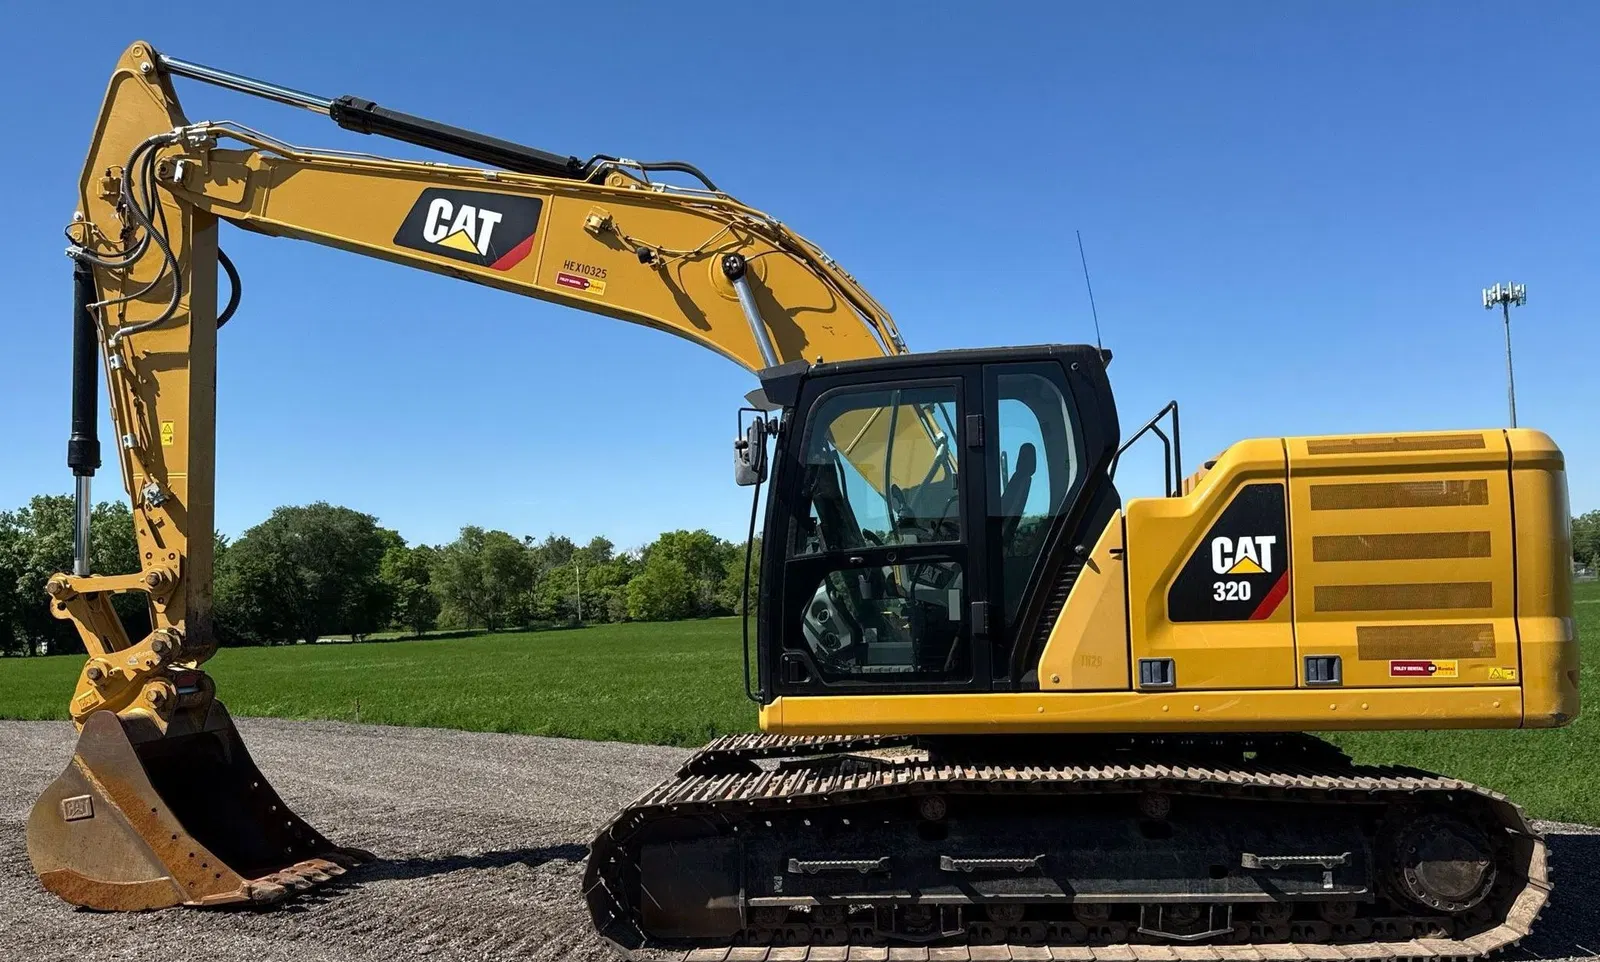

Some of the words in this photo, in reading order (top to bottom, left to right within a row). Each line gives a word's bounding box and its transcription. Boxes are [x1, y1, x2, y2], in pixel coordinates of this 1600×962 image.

[423, 198, 503, 256] CAT
[563, 259, 607, 279] HEX10325
[1211, 535, 1276, 574] CAT
[1213, 581, 1251, 602] 320
